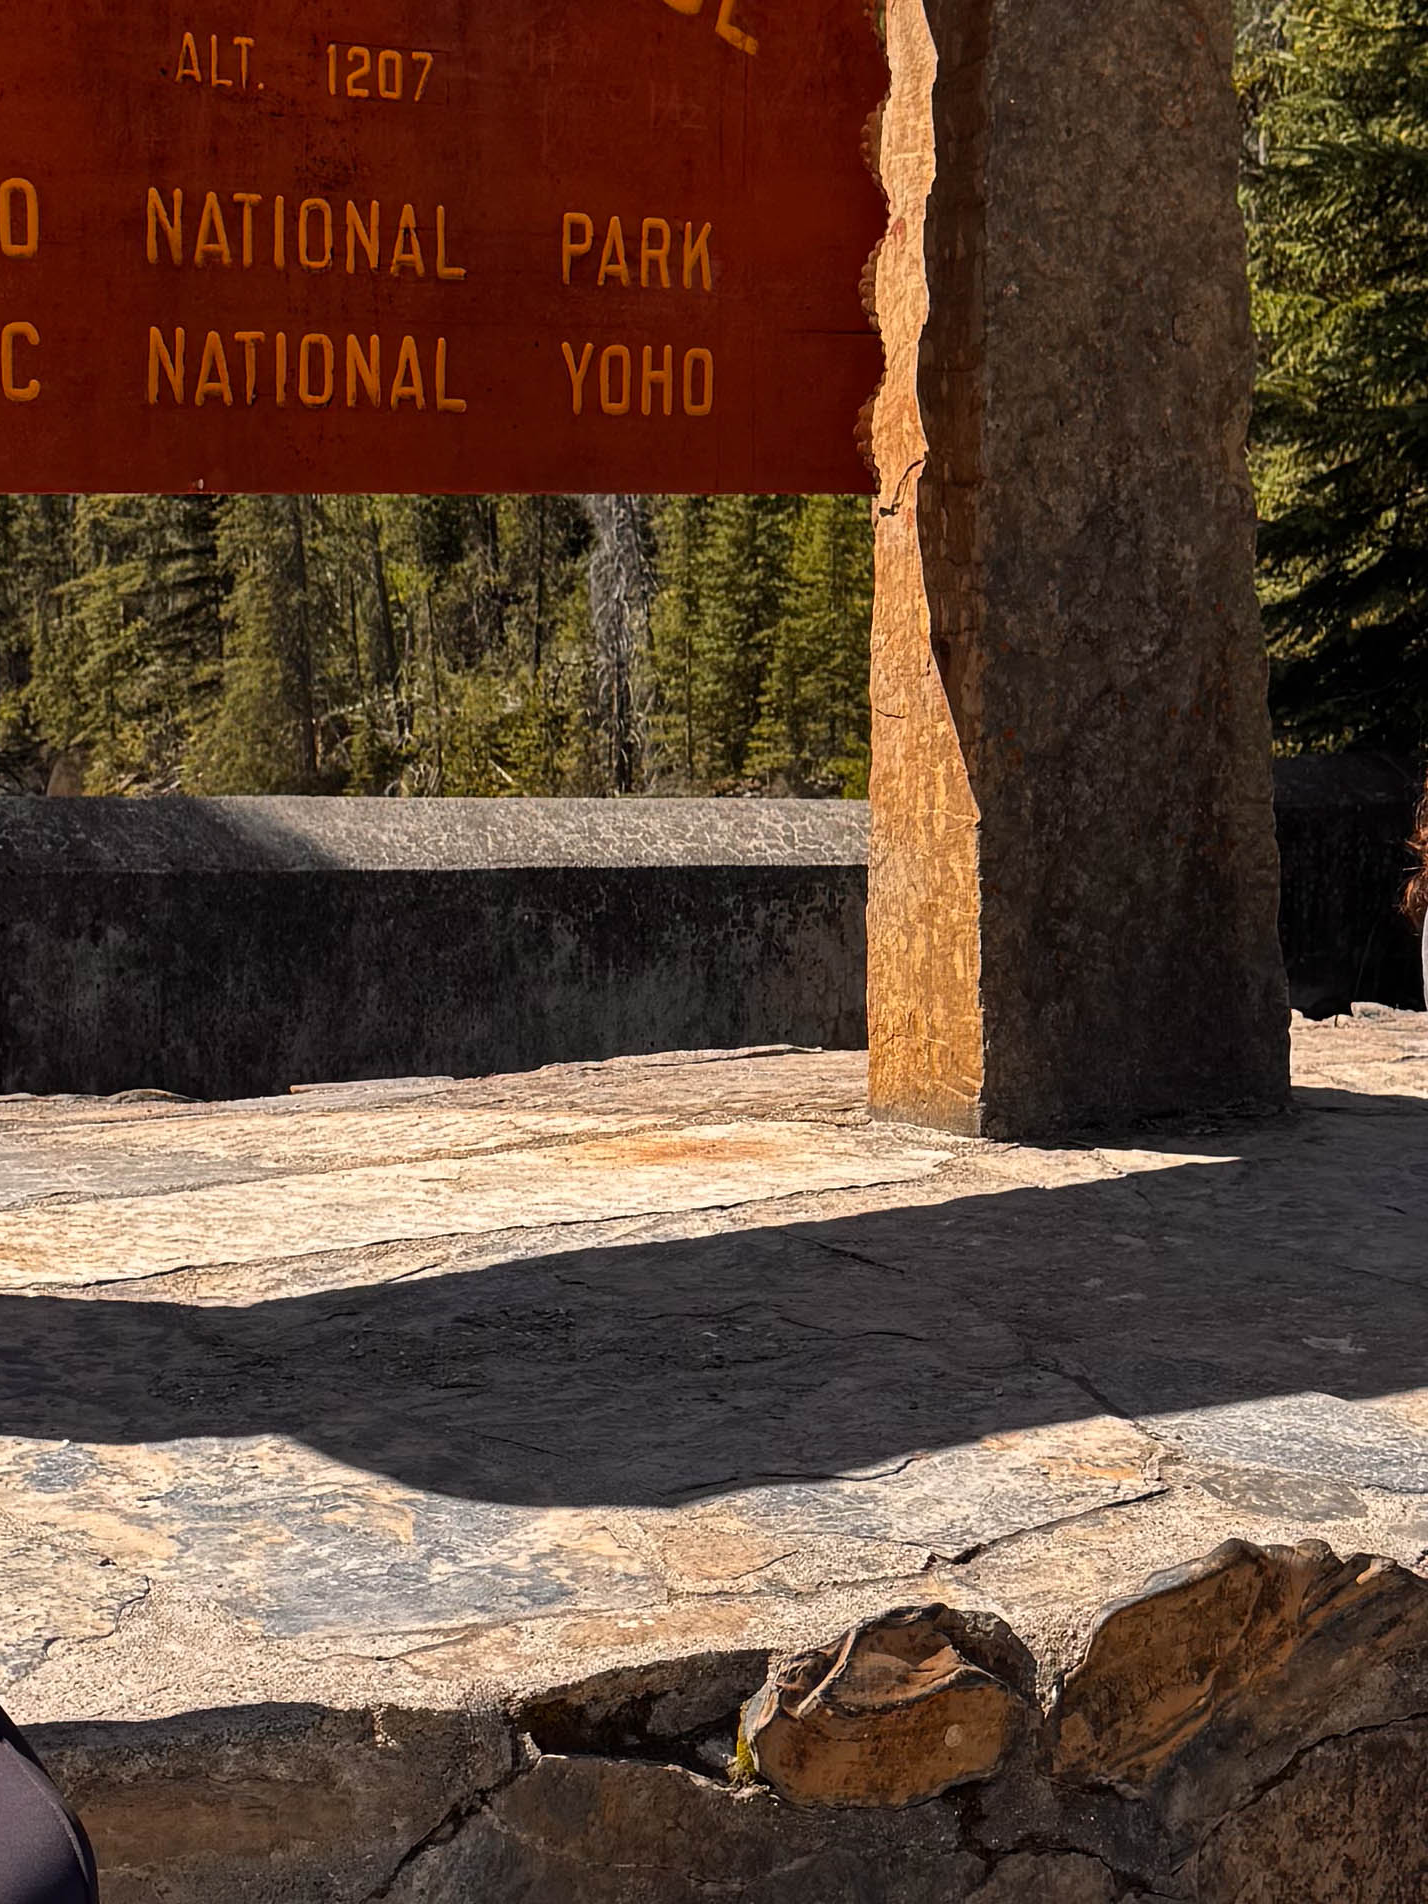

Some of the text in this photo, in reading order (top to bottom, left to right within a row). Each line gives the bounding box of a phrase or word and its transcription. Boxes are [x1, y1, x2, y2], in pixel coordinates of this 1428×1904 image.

[176, 31, 434, 102] ALT. 1207
[146, 186, 467, 281] NATIONAL
[561, 211, 714, 292] PARK
[147, 326, 468, 413] NATIONAL
[560, 341, 715, 418] YOHO
